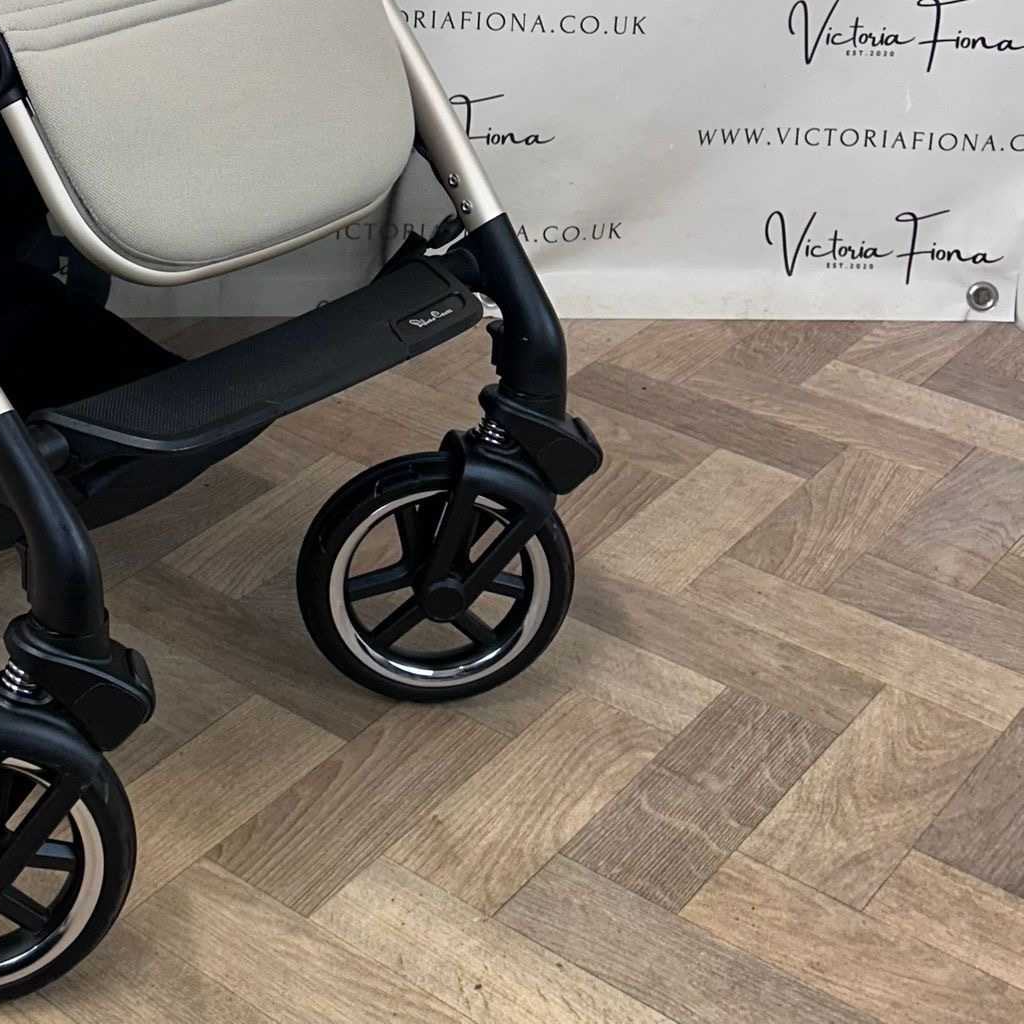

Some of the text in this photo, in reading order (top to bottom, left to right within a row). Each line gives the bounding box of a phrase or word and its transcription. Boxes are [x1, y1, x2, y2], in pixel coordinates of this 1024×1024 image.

[845, 49, 895, 58] EST.2020
[764, 208, 1005, 287] Victoria Fiona
[826, 261, 874, 270] EST.2020
